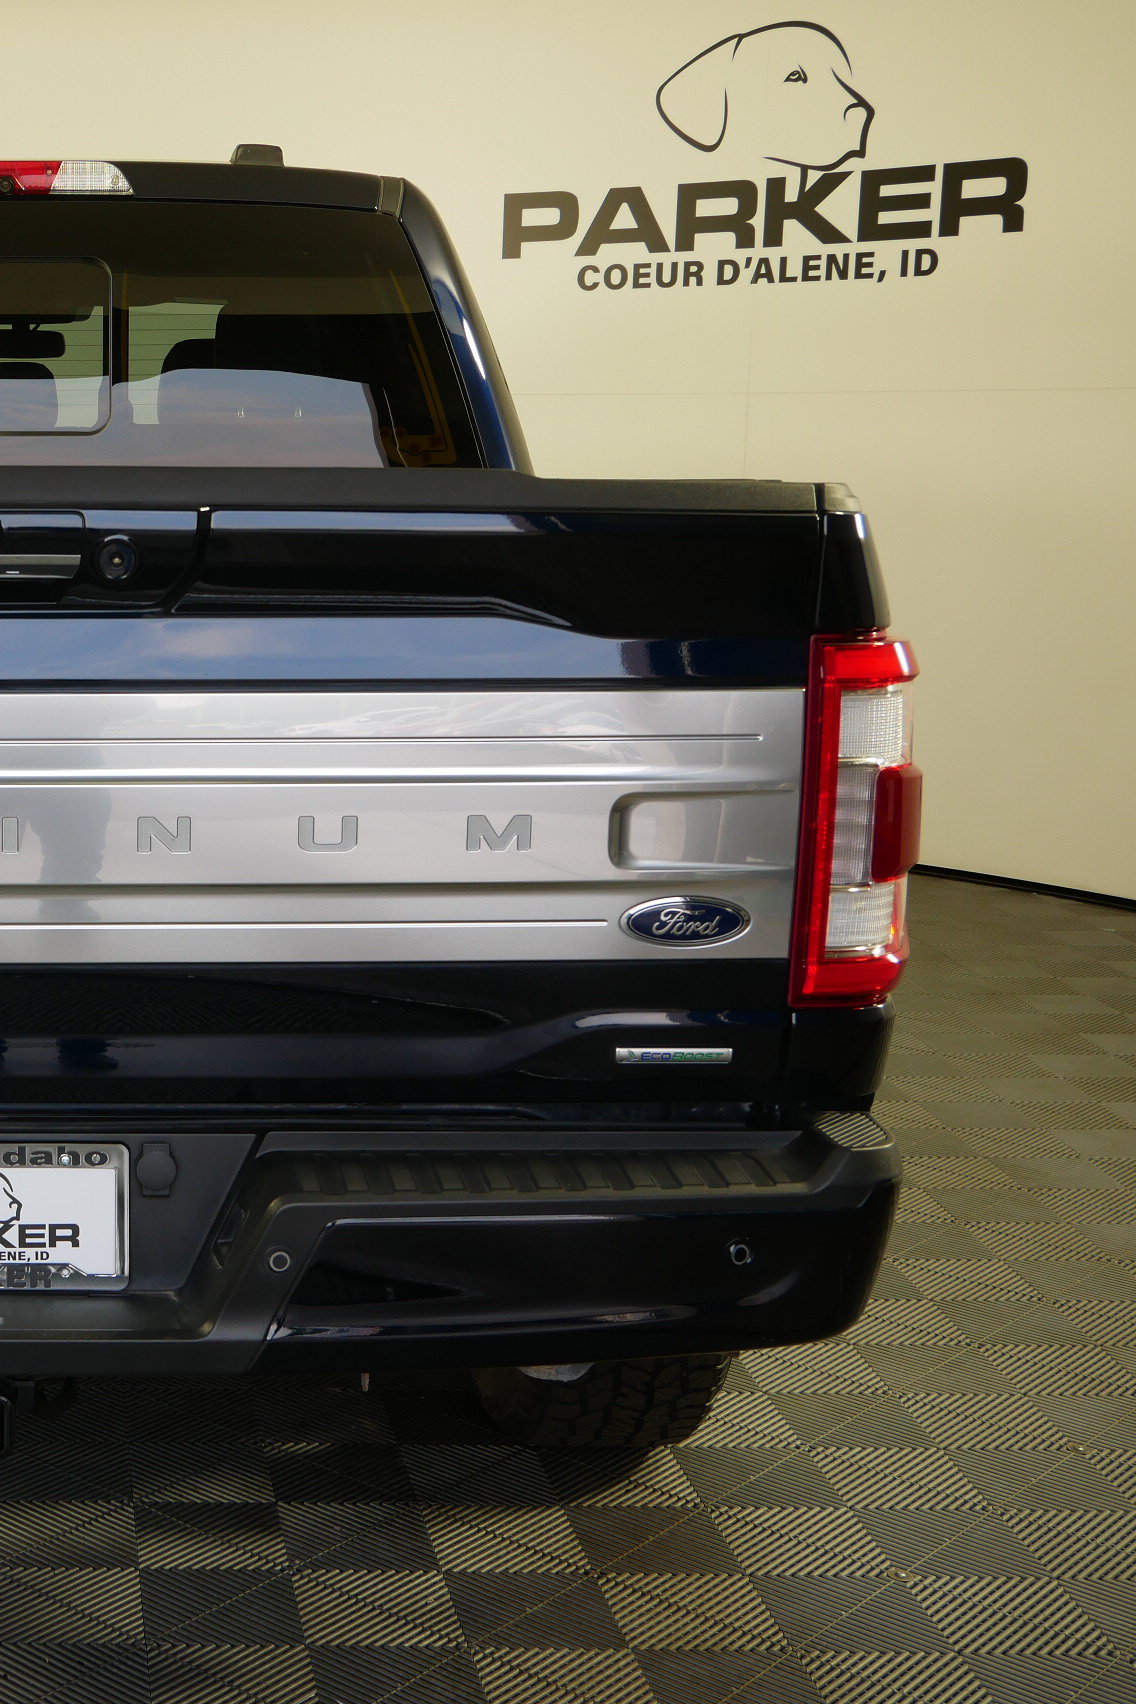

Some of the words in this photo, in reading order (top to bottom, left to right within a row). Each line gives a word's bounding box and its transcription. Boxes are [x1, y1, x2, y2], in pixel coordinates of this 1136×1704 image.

[501, 156, 1029, 260] PARKER
[576, 260, 705, 291] COEUR
[716, 251, 887, 283] D'ALENE,
[899, 248, 939, 277] ID
[651, 907, 720, 936] Ford
[35, 1251, 50, 1261] ID
